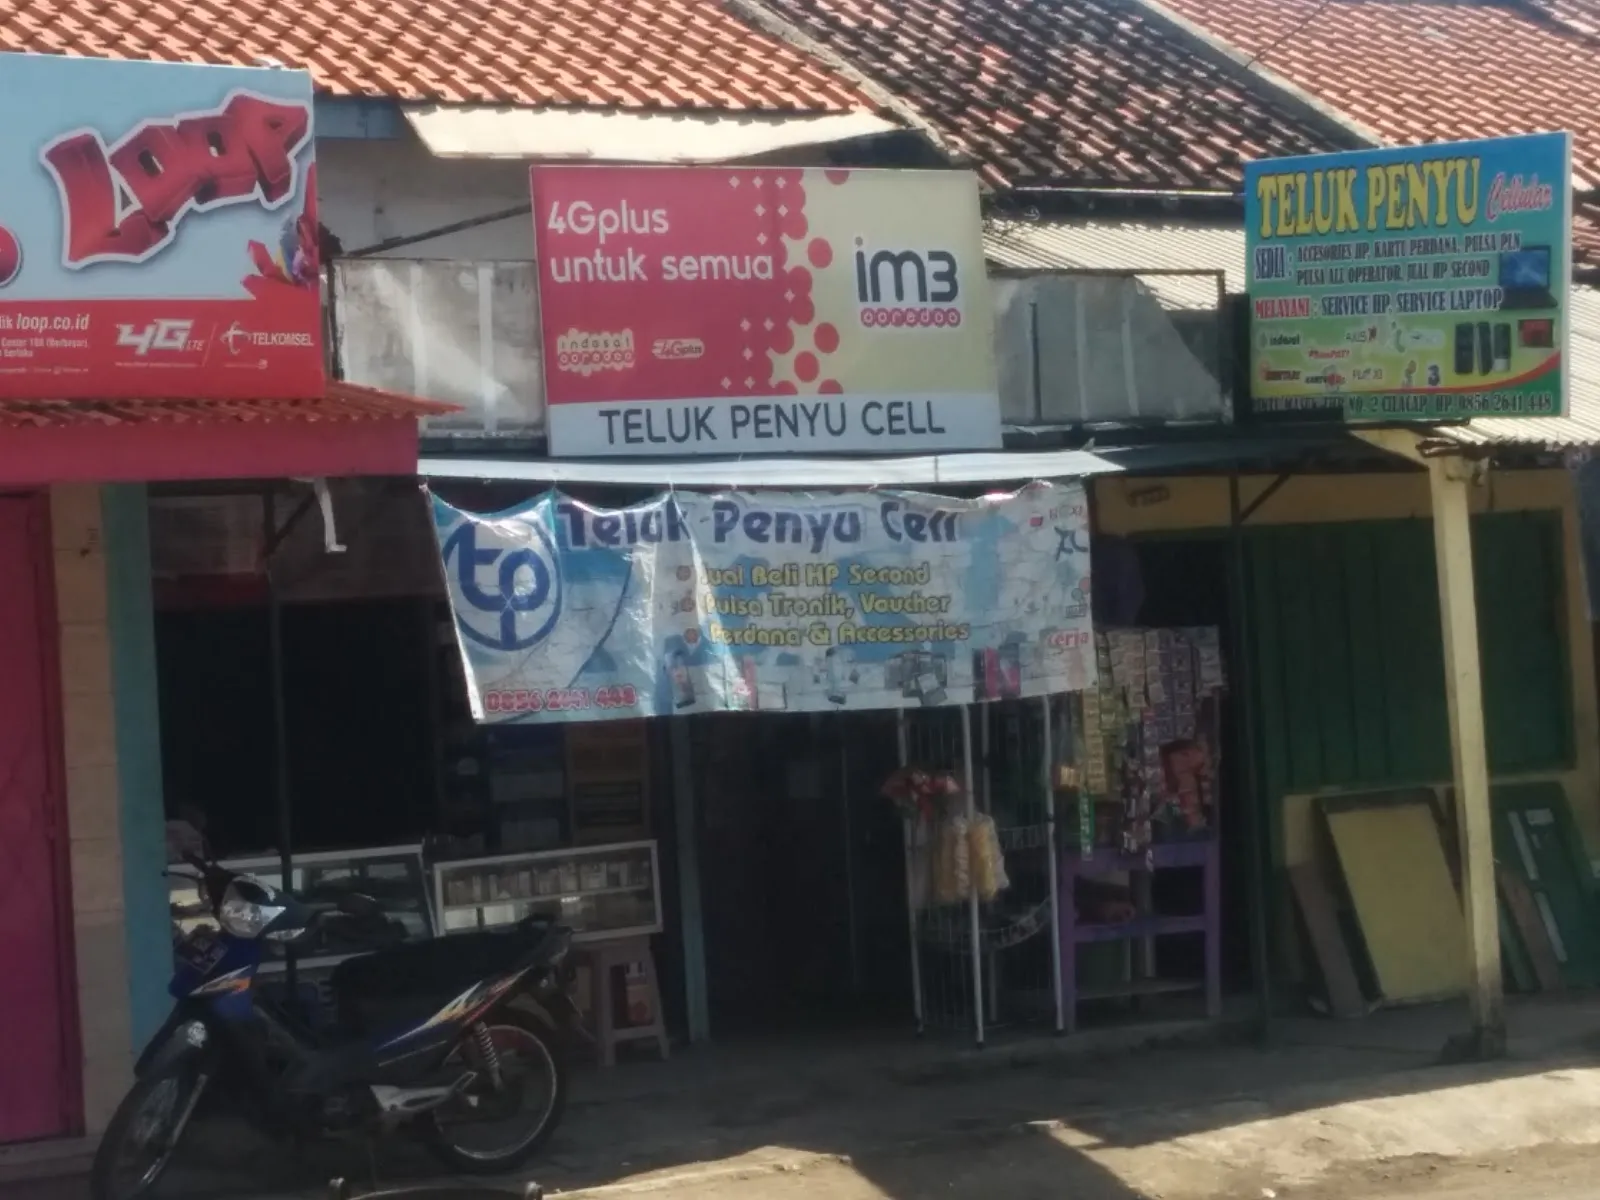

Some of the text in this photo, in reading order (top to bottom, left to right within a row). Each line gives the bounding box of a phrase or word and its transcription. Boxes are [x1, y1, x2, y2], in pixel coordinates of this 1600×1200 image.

[1257, 166, 1360, 239] TELUK
[1366, 157, 1481, 231] PENYU
[548, 199, 670, 244] 4Gplus
[551, 247, 774, 283] untuk semua
[855, 236, 959, 303] im3
[1255, 245, 1285, 280] SEDIA
[1450, 259, 1490, 277] SECOND
[861, 307, 961, 328] ooredoo
[1256, 298, 1310, 319] MELAYANI
[1321, 296, 1369, 316] SERVICE
[1396, 291, 1445, 312] SERVICE
[1449, 288, 1502, 311] LAPTOP
[16, 312, 91, 333] loop.co.id
[115, 318, 194, 357] 4G
[252, 332, 315, 347] TELKOMSEL
[599, 400, 947, 446] TELUK PENYU CELL
[712, 500, 862, 554] Penyu
[751, 563, 799, 587] Beli
[805, 563, 840, 587] HP
[849, 561, 931, 586] Second
[859, 591, 953, 614] Vaucher
[807, 624, 831, 646] &
[836, 621, 971, 646] Accessories
